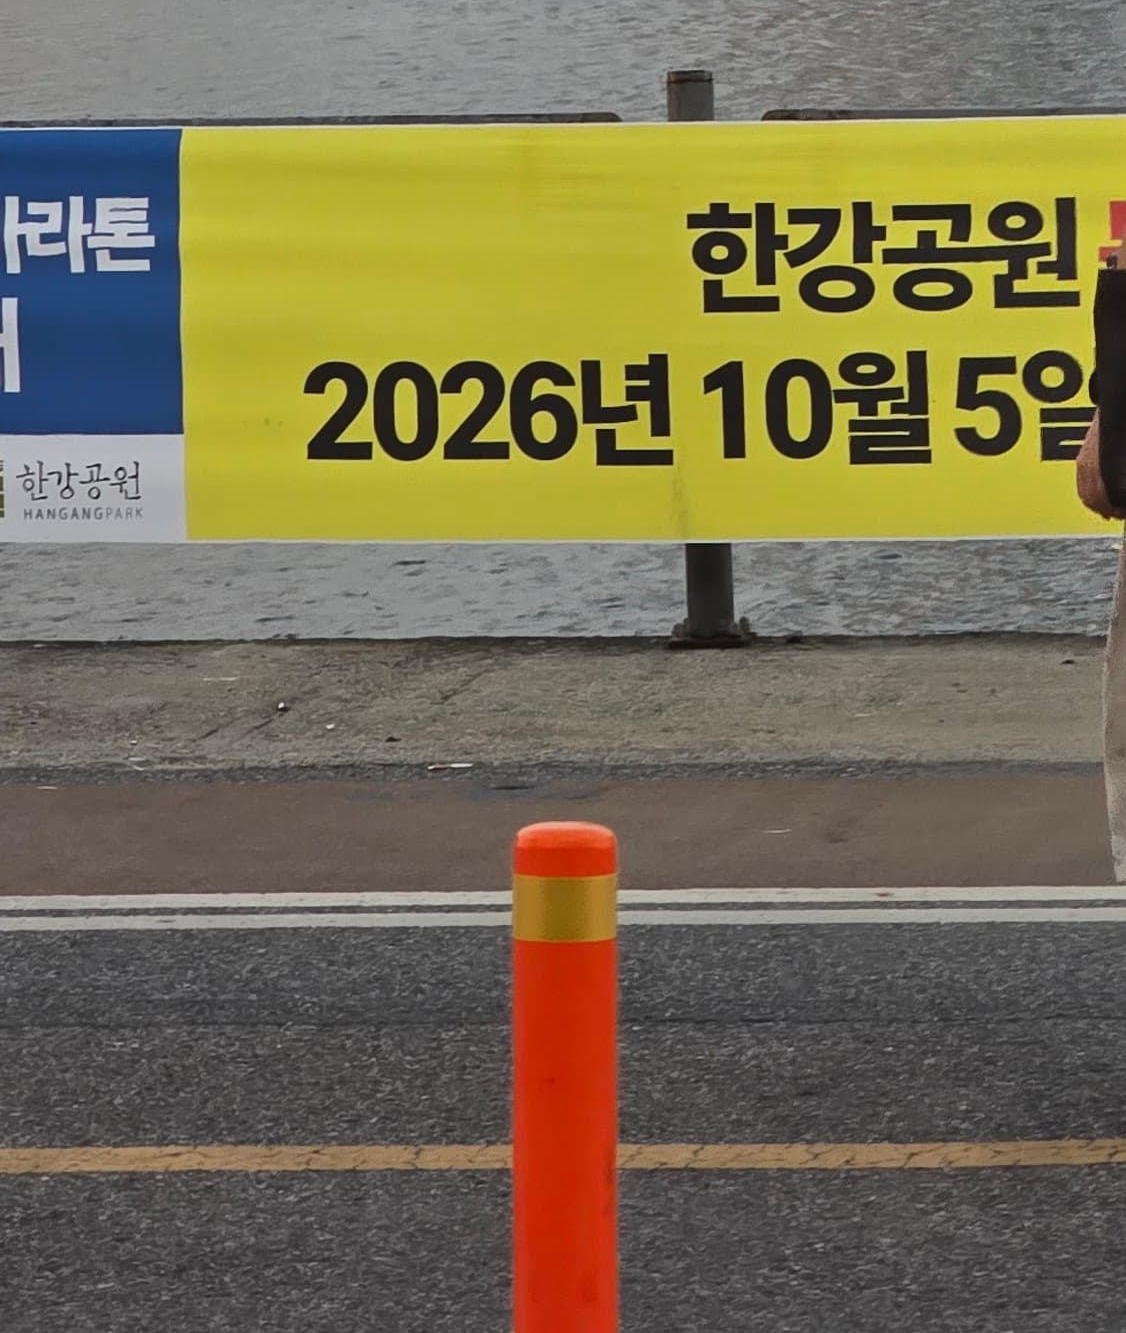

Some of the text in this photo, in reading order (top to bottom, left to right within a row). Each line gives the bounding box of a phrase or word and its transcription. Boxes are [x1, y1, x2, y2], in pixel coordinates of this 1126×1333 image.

[686, 197, 1081, 314] 한강공원
[303, 353, 674, 467] 2026년
[703, 350, 932, 465] 10월
[16, 460, 142, 502] 한강공원
